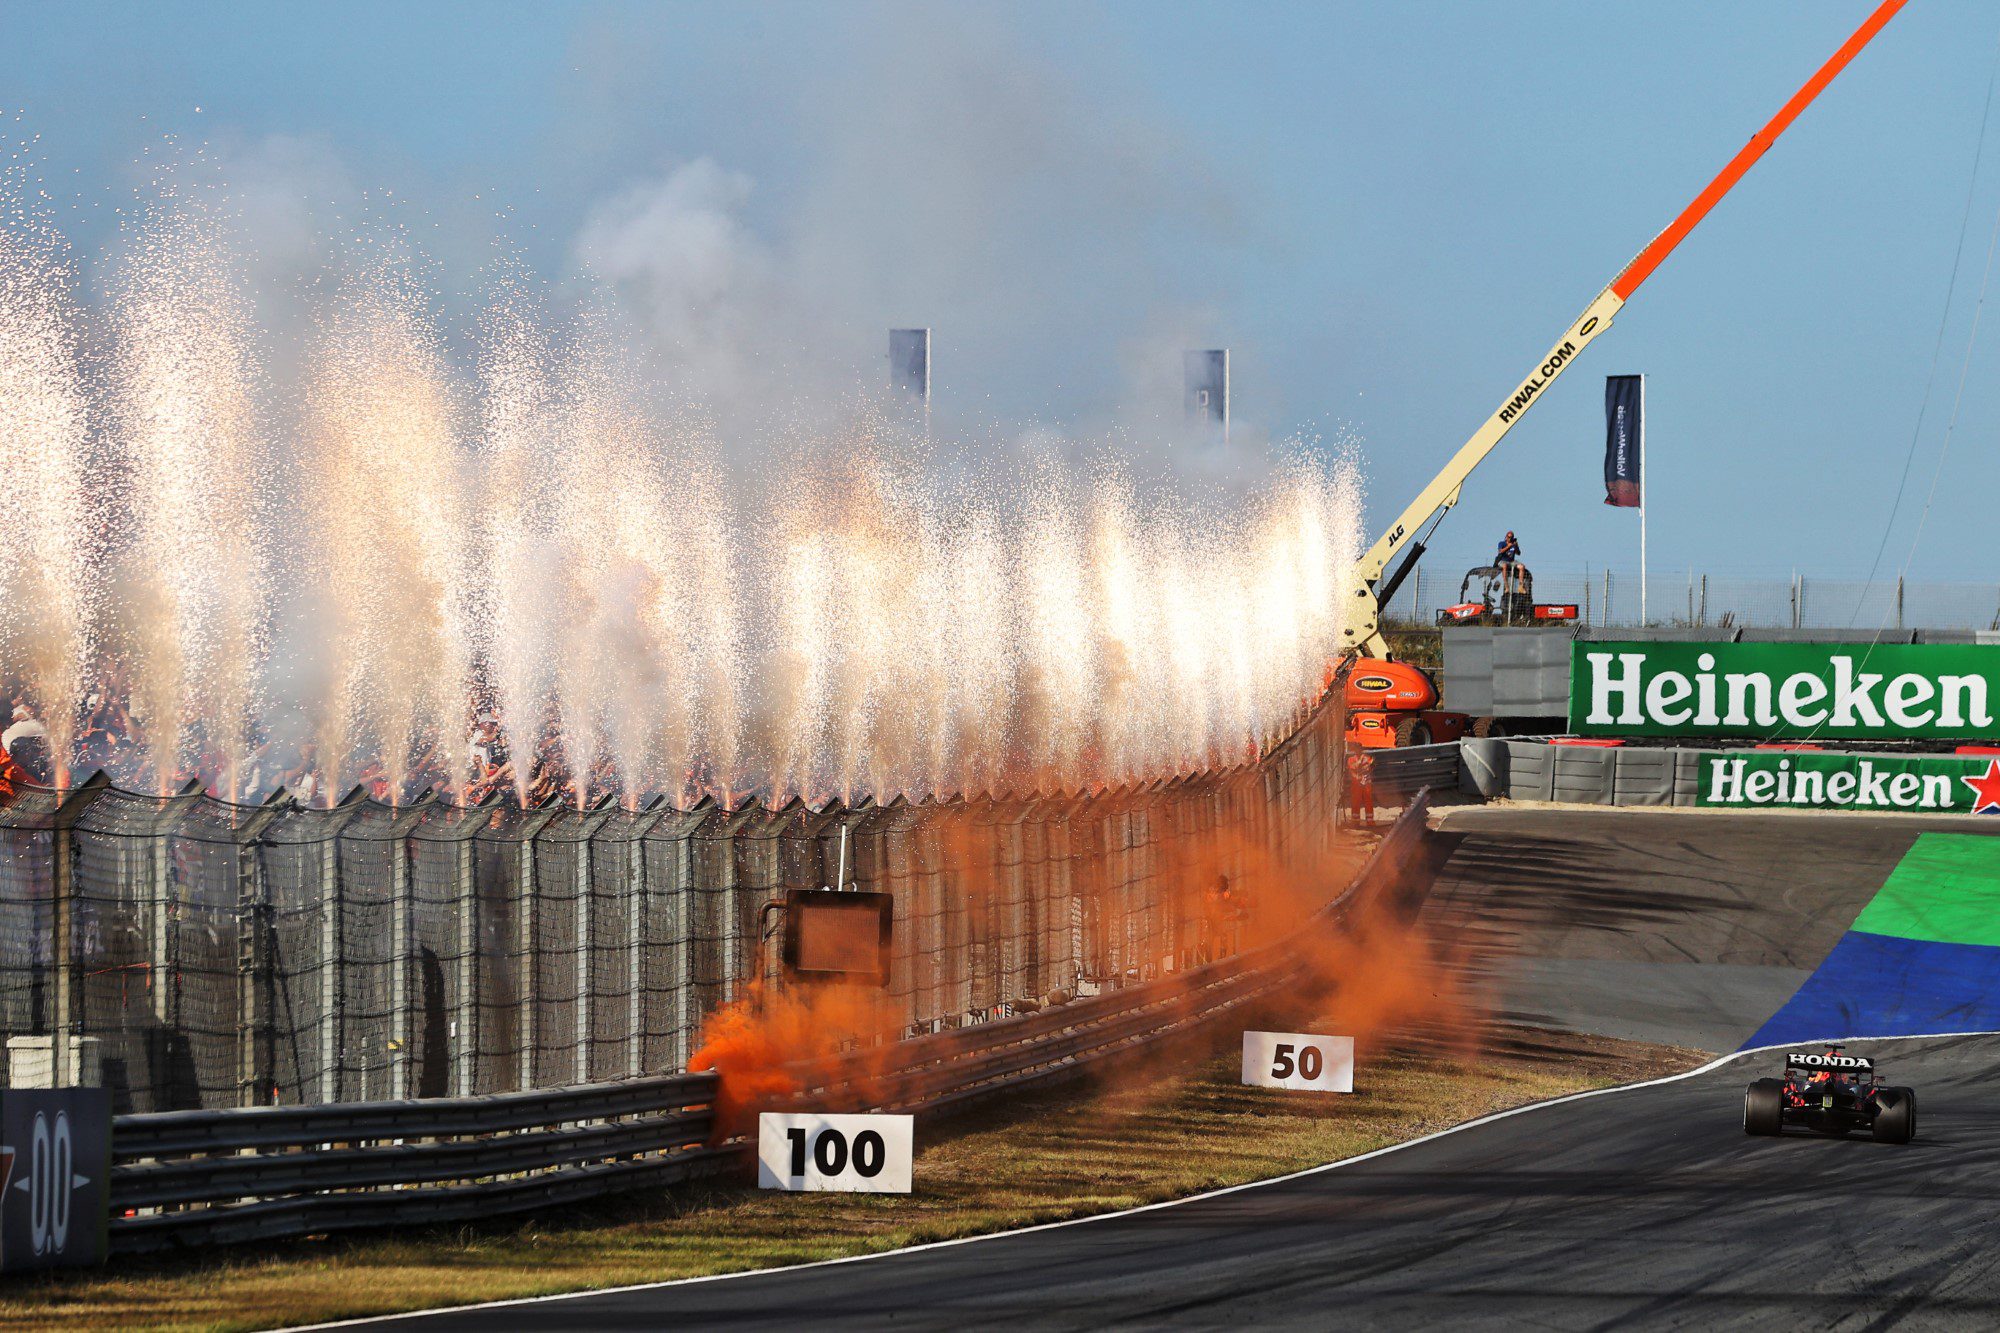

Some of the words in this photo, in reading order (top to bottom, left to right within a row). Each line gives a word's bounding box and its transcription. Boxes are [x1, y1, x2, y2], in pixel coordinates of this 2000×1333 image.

[1388, 524, 1405, 547] JLG
[1586, 652, 1994, 728] Heineken
[1706, 759, 1955, 808] Heineken
[1270, 1043, 1323, 1081] 50
[1788, 1053, 1872, 1068] HONDA
[787, 1127, 886, 1178] 100
